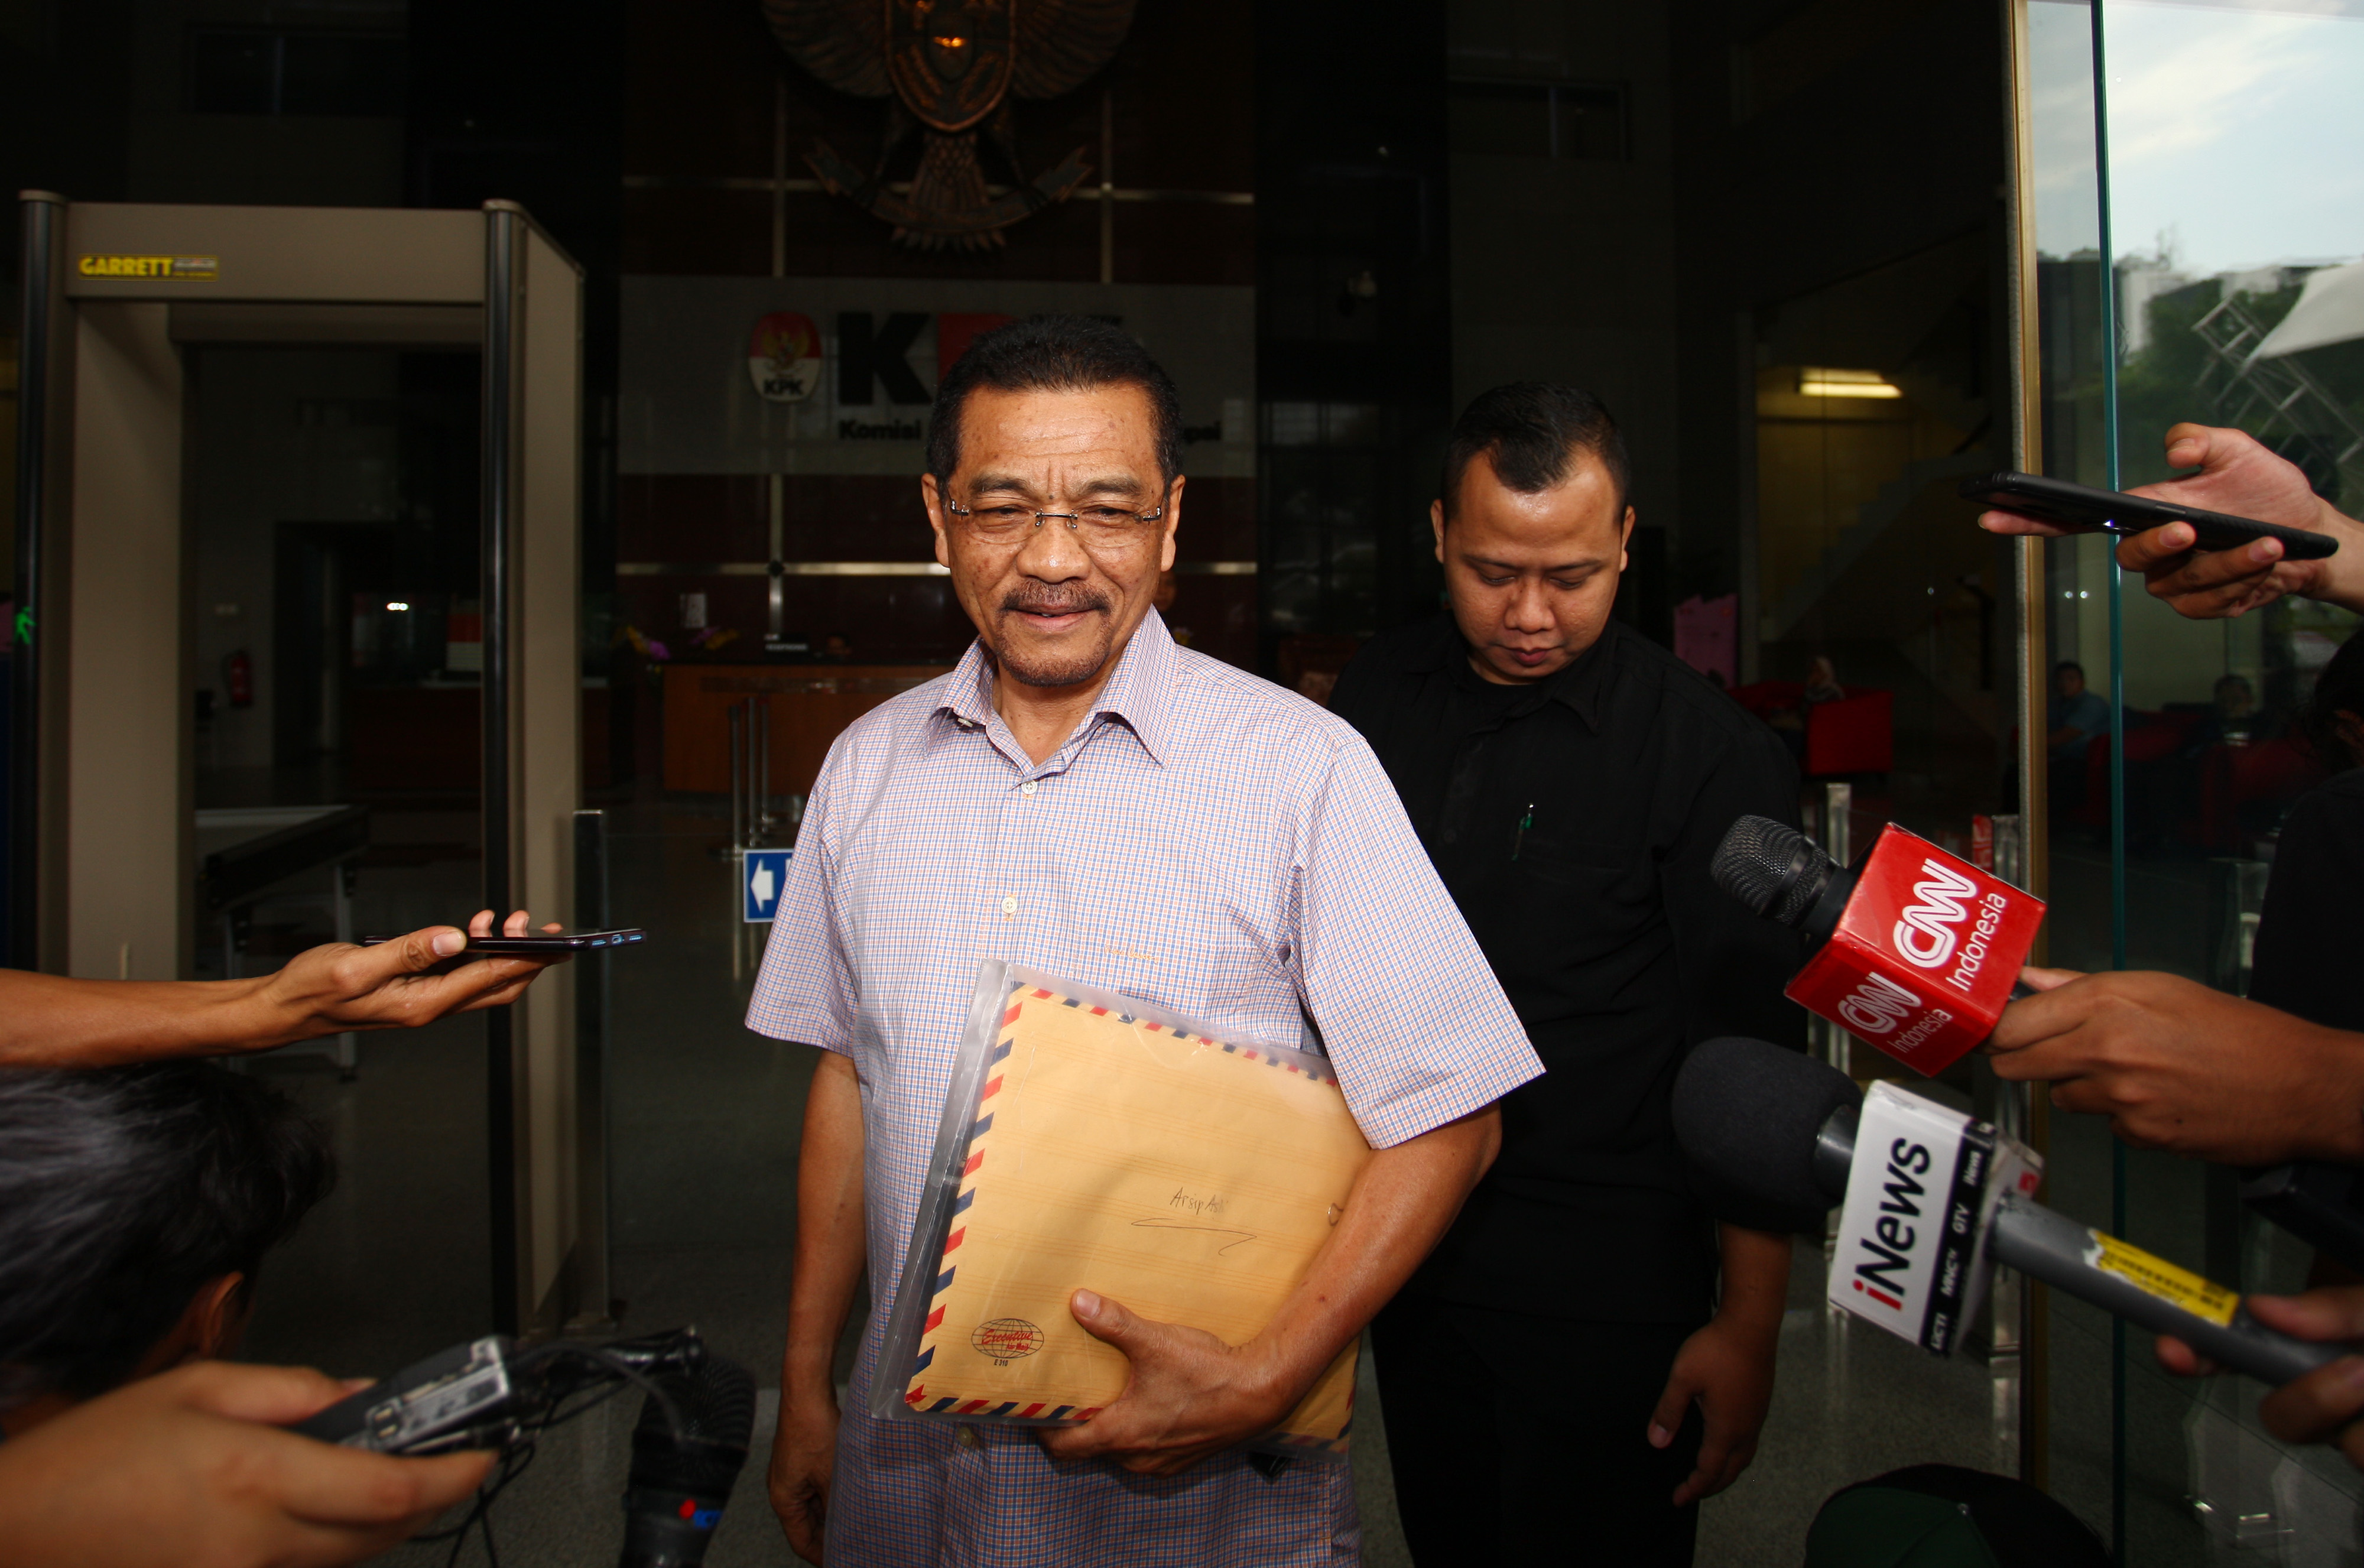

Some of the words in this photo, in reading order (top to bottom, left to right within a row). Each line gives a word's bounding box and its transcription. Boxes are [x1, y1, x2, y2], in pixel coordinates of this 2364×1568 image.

[79, 257, 174, 277] GARRETT
[764, 379, 803, 394] KPK
[840, 419, 921, 440] Komisi
[1893, 858, 1977, 968] CNN
[1946, 892, 2006, 992] Indonesia
[1837, 971, 1921, 1034] CNN
[1887, 1008, 1953, 1053] Indonesia
[1852, 1137, 1931, 1311] iNews
[1953, 1202, 1970, 1235] GTV
